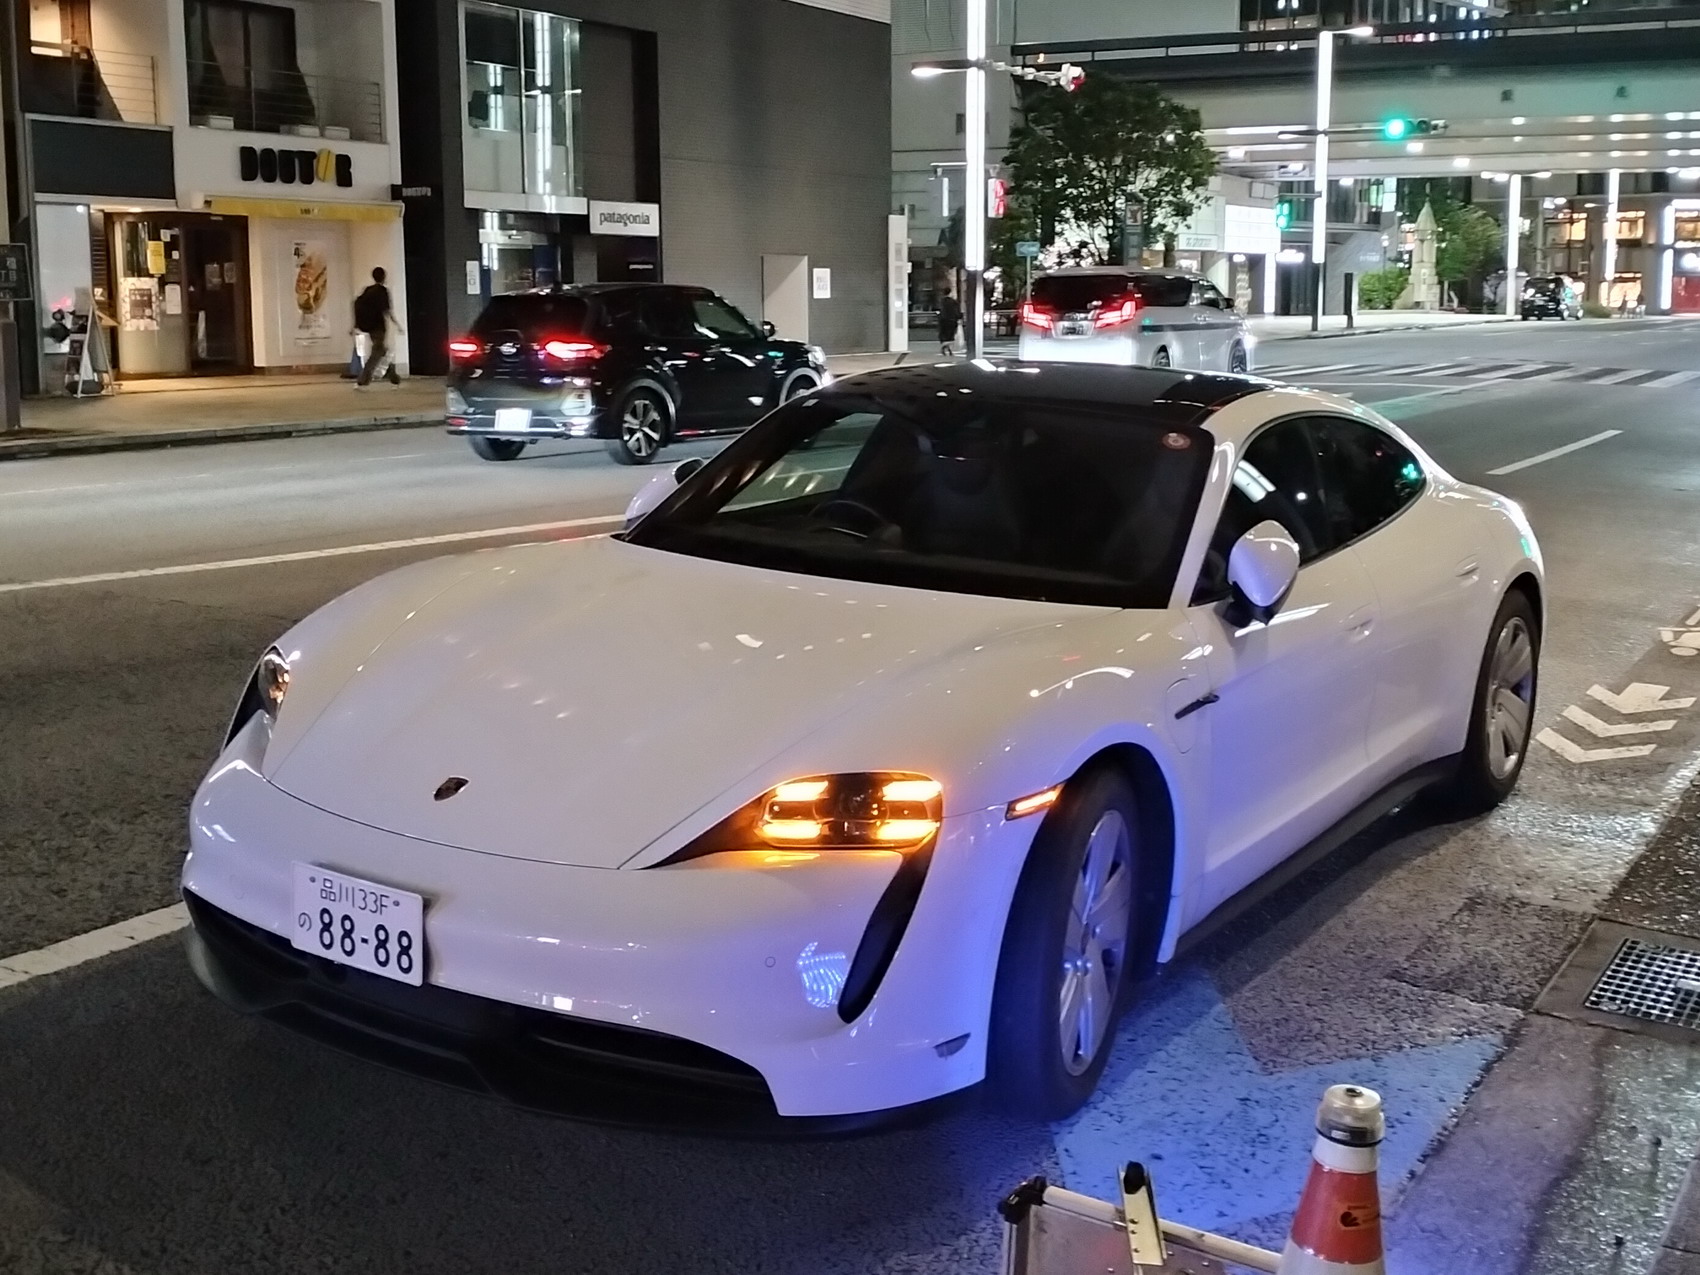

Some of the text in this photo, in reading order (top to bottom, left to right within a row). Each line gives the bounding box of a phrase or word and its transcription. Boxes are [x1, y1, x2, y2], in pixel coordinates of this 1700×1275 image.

[240, 146, 353, 187] DOUTOR
[599, 211, 650, 227] patagonia
[298, 907, 413, 974] の 88-88
